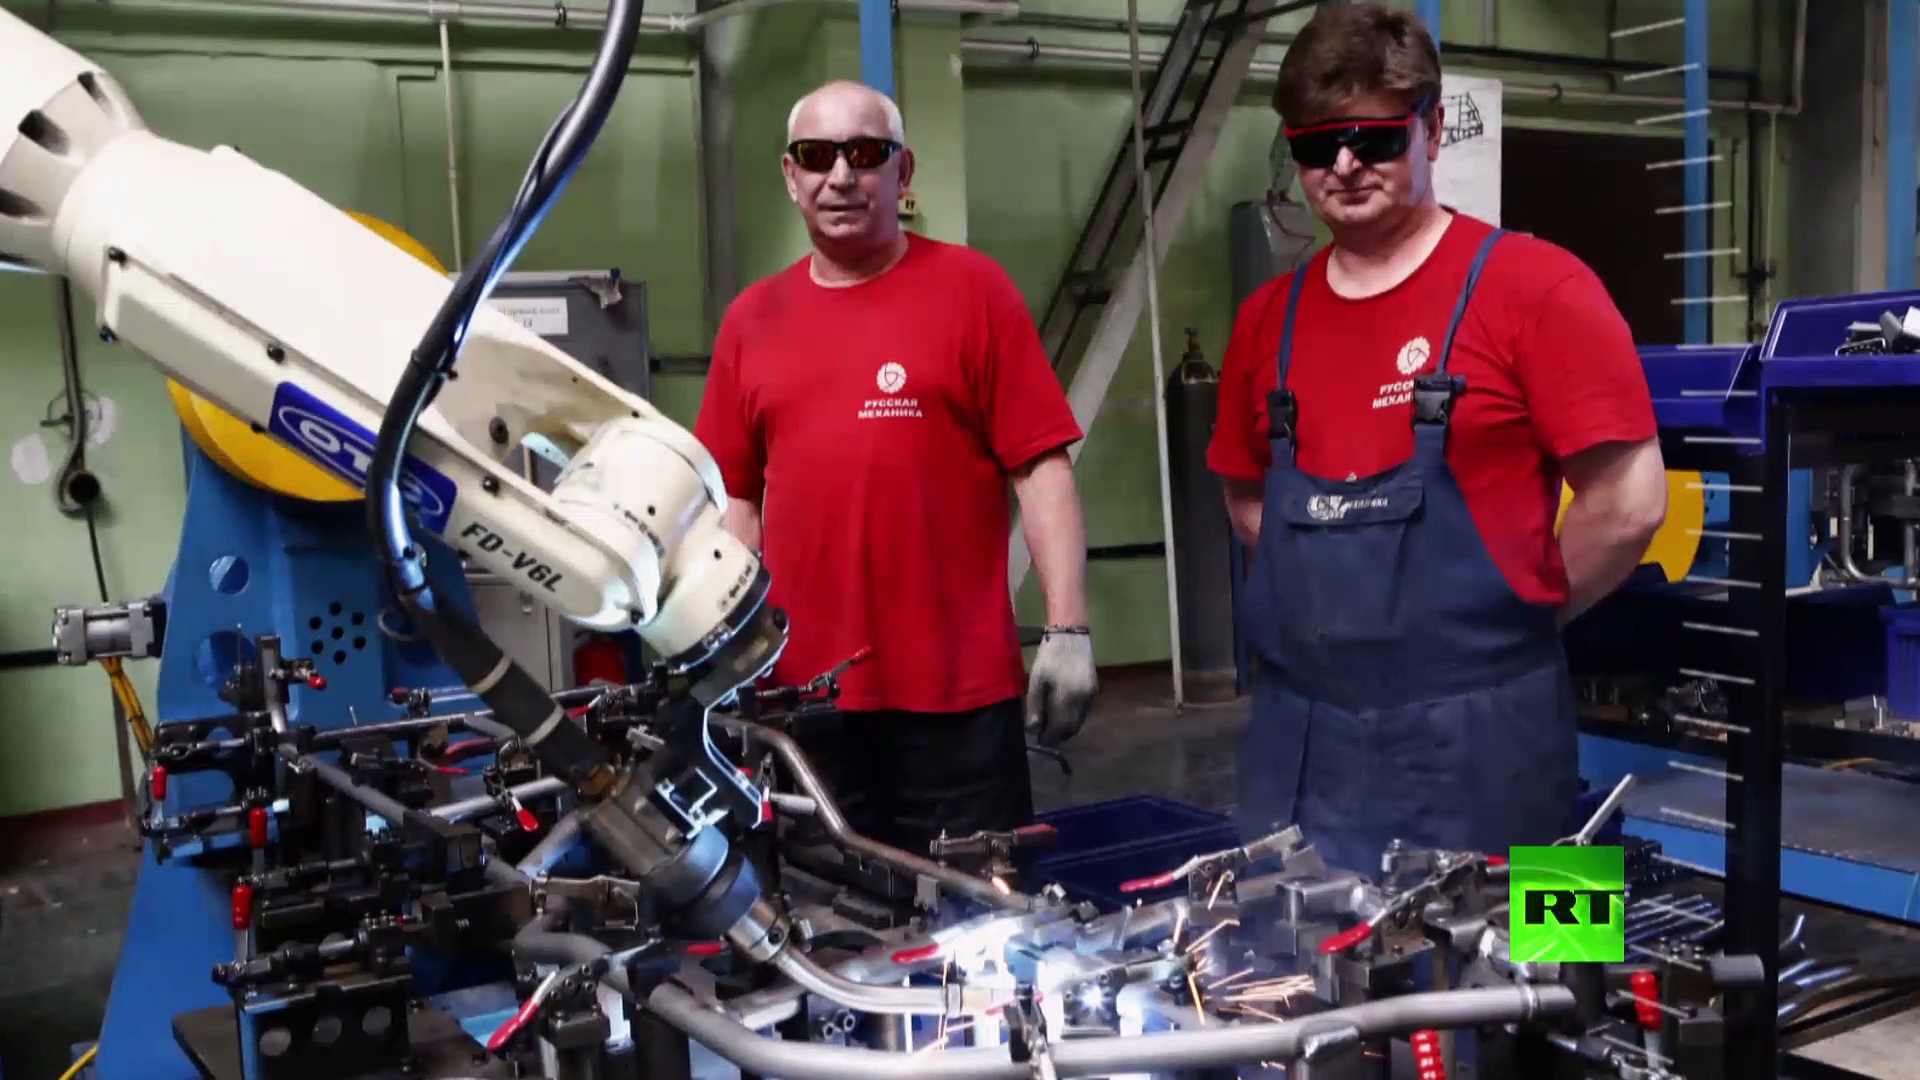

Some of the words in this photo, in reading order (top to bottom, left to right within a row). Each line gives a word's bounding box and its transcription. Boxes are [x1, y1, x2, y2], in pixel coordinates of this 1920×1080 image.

[864, 398, 918, 408] РУССКАЯ
[857, 408, 923, 419] МЕХАНИКА
[461, 521, 564, 593] FD-V6L
